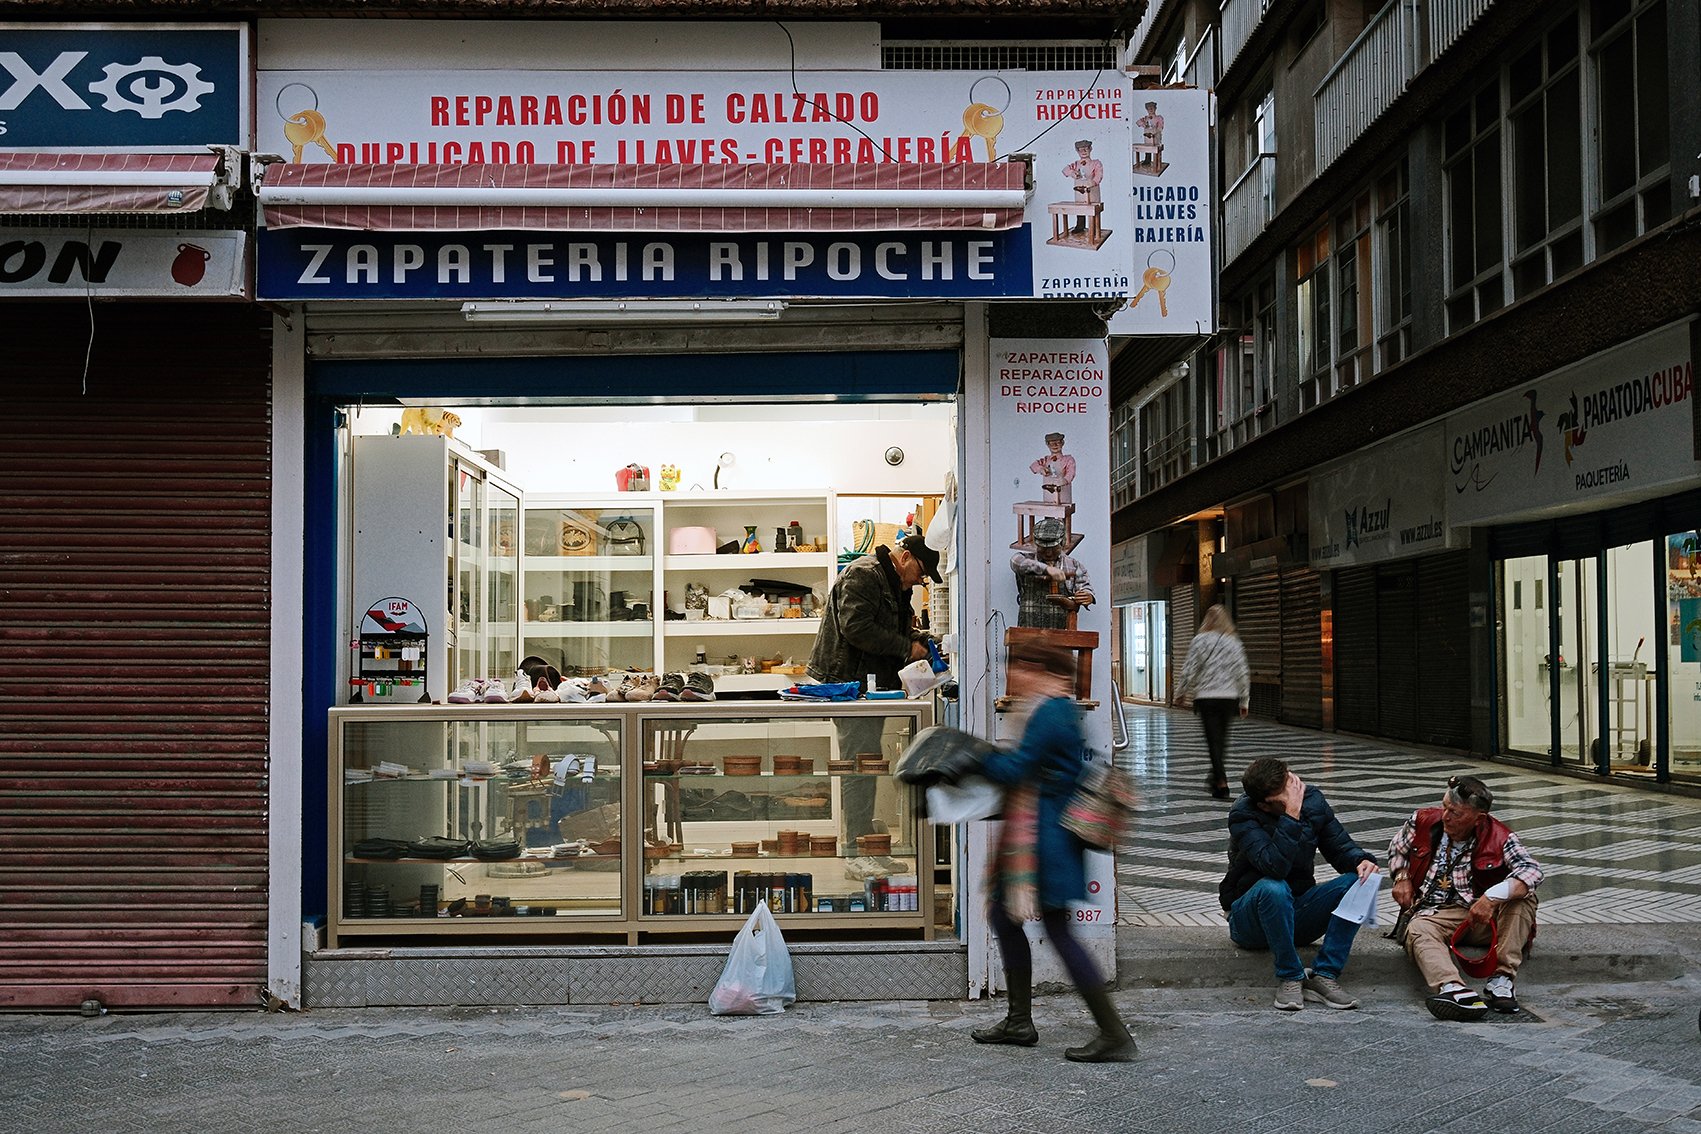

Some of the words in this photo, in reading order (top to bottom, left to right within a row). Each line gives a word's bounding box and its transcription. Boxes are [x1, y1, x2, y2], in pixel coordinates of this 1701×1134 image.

[1036, 88, 1122, 100] ZAPATERIA
[431, 89, 651, 127] REPARACIÓN
[666, 93, 706, 125] DE
[726, 91, 879, 124] CALZADO
[1036, 103, 1122, 121] RIPOCHE
[336, 140, 535, 164] DUPLICADO
[556, 140, 596, 164] DE
[1137, 203, 1197, 220] LLAVES
[297, 242, 675, 284] ZAPATERIA
[709, 241, 995, 281] RIPOCHE
[1007, 350, 1096, 364] ZAPATERÍA
[1000, 367, 1103, 381] REPARACIÓN
[1001, 385, 1022, 397] DE
[1027, 385, 1103, 398] CALZADO
[1583, 361, 1695, 430] PARATODACUBA
[1016, 402, 1087, 414] RIPOCHE
[1453, 413, 1534, 465] CAMPANITA
[1575, 459, 1631, 491] PAQUETERÍA
[1359, 498, 1392, 535] Azzul
[388, 602, 408, 611] IFAM
[1076, 909, 1102, 922] 987
